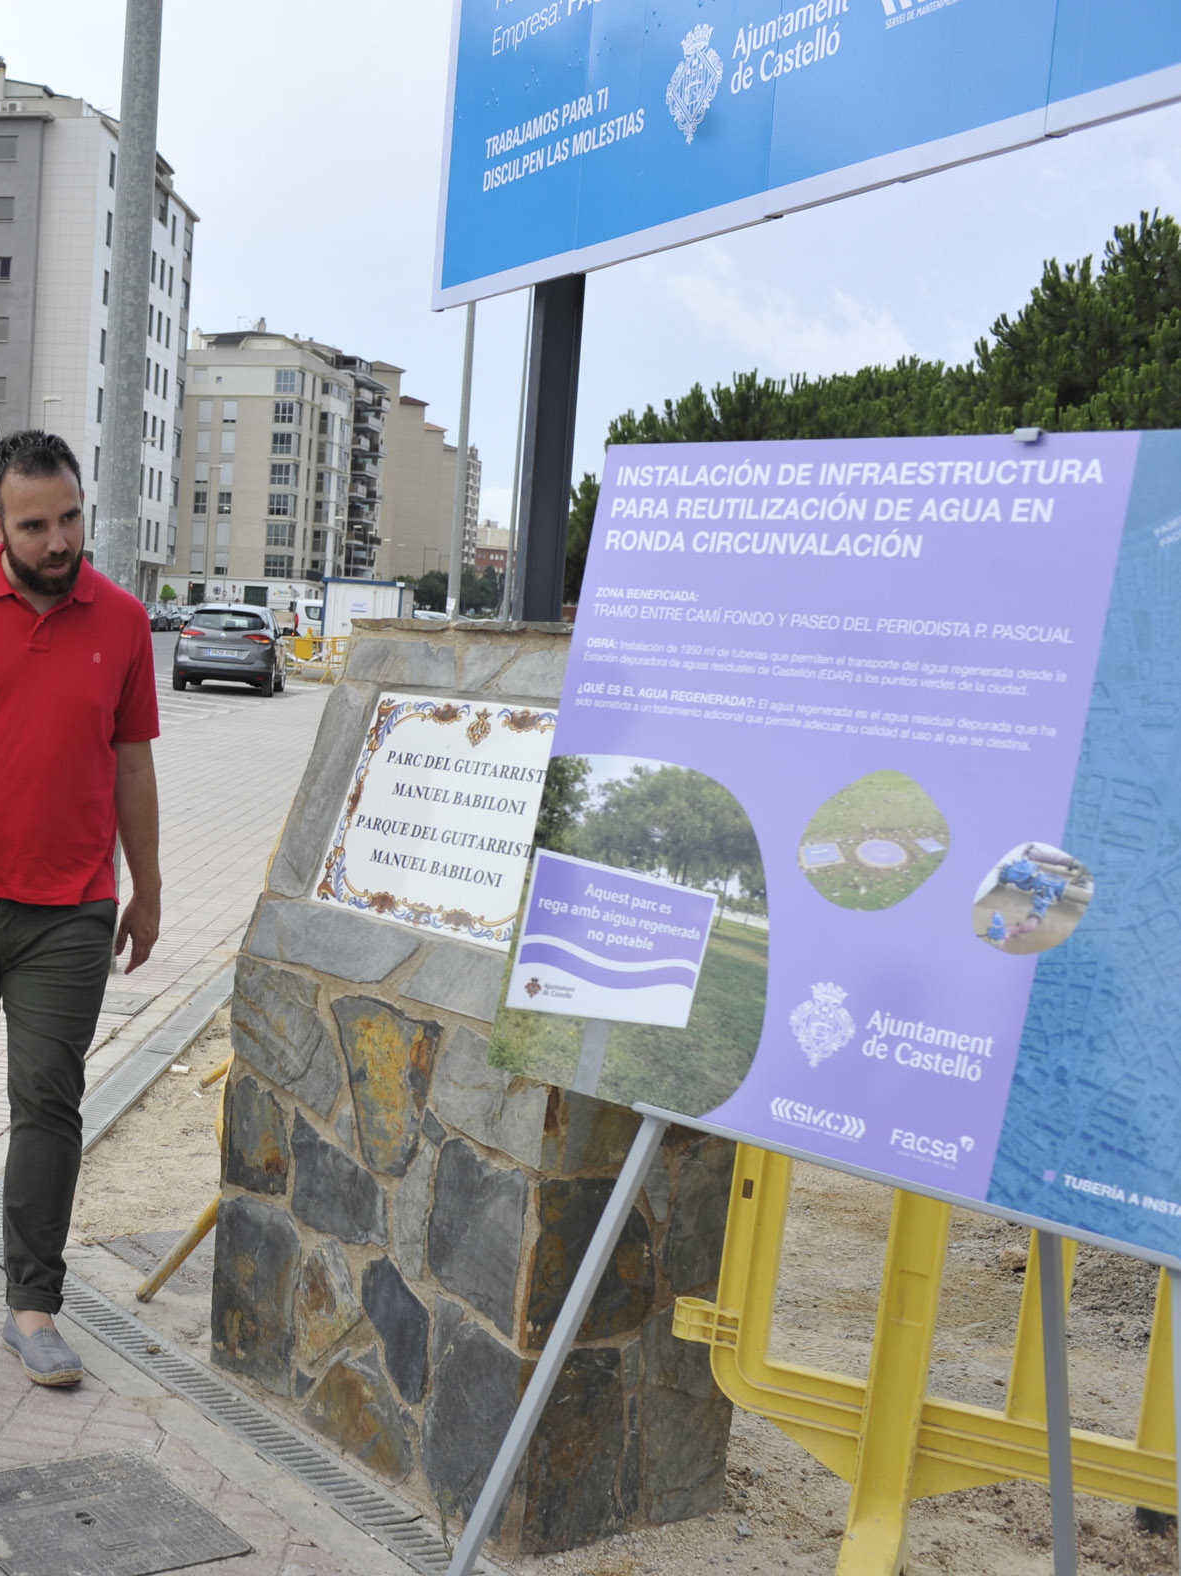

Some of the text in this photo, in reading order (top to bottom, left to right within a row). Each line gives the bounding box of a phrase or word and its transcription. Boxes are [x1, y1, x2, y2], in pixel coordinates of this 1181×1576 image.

[492, 1, 562, 57] Empresa:
[730, 22, 841, 95] de Castelló
[486, 87, 609, 160] TRABAJAMOS PARA TI
[483, 108, 644, 192] DISCULPEN LAS MOLESTIAS
[616, 458, 1104, 486] INSTALACIÓN DE INFRAESTRUCTURA
[611, 492, 1055, 522] PARA REUTILIZACIÓN DE AGUA EN
[604, 528, 923, 558] RONDA CIRCUNVALACIÓN
[595, 587, 699, 601] ZONA BENEFICIADA:
[593, 603, 1075, 643] TRAMO ENTRE CAMÍ FONDO Y PASEO DEL PERIODISTA P. PASCUAL
[586, 638, 618, 649] OBRA:
[577, 681, 605, 695] ¿QUÉ
[607, 684, 621, 696] ES
[623, 685, 636, 697] EL
[638, 687, 668, 700] AGUA
[670, 690, 756, 708] REGENERADA?:
[386, 750, 547, 784] PARC DEL GUITARRIST
[392, 782, 527, 816] MANUEL BABILONI
[355, 814, 531, 859] PARQUE DEL GUITARRIST
[369, 848, 503, 888] MANUEL BABILONI
[538, 896, 700, 941] rega amb aigua regenerada
[585, 883, 672, 915] Aquest parc es
[587, 928, 655, 951] no potable
[867, 1009, 994, 1058] Ajuntament
[862, 1034, 982, 1082] de Castelló
[1064, 1173, 1181, 1217] TUBERÍA A INST
